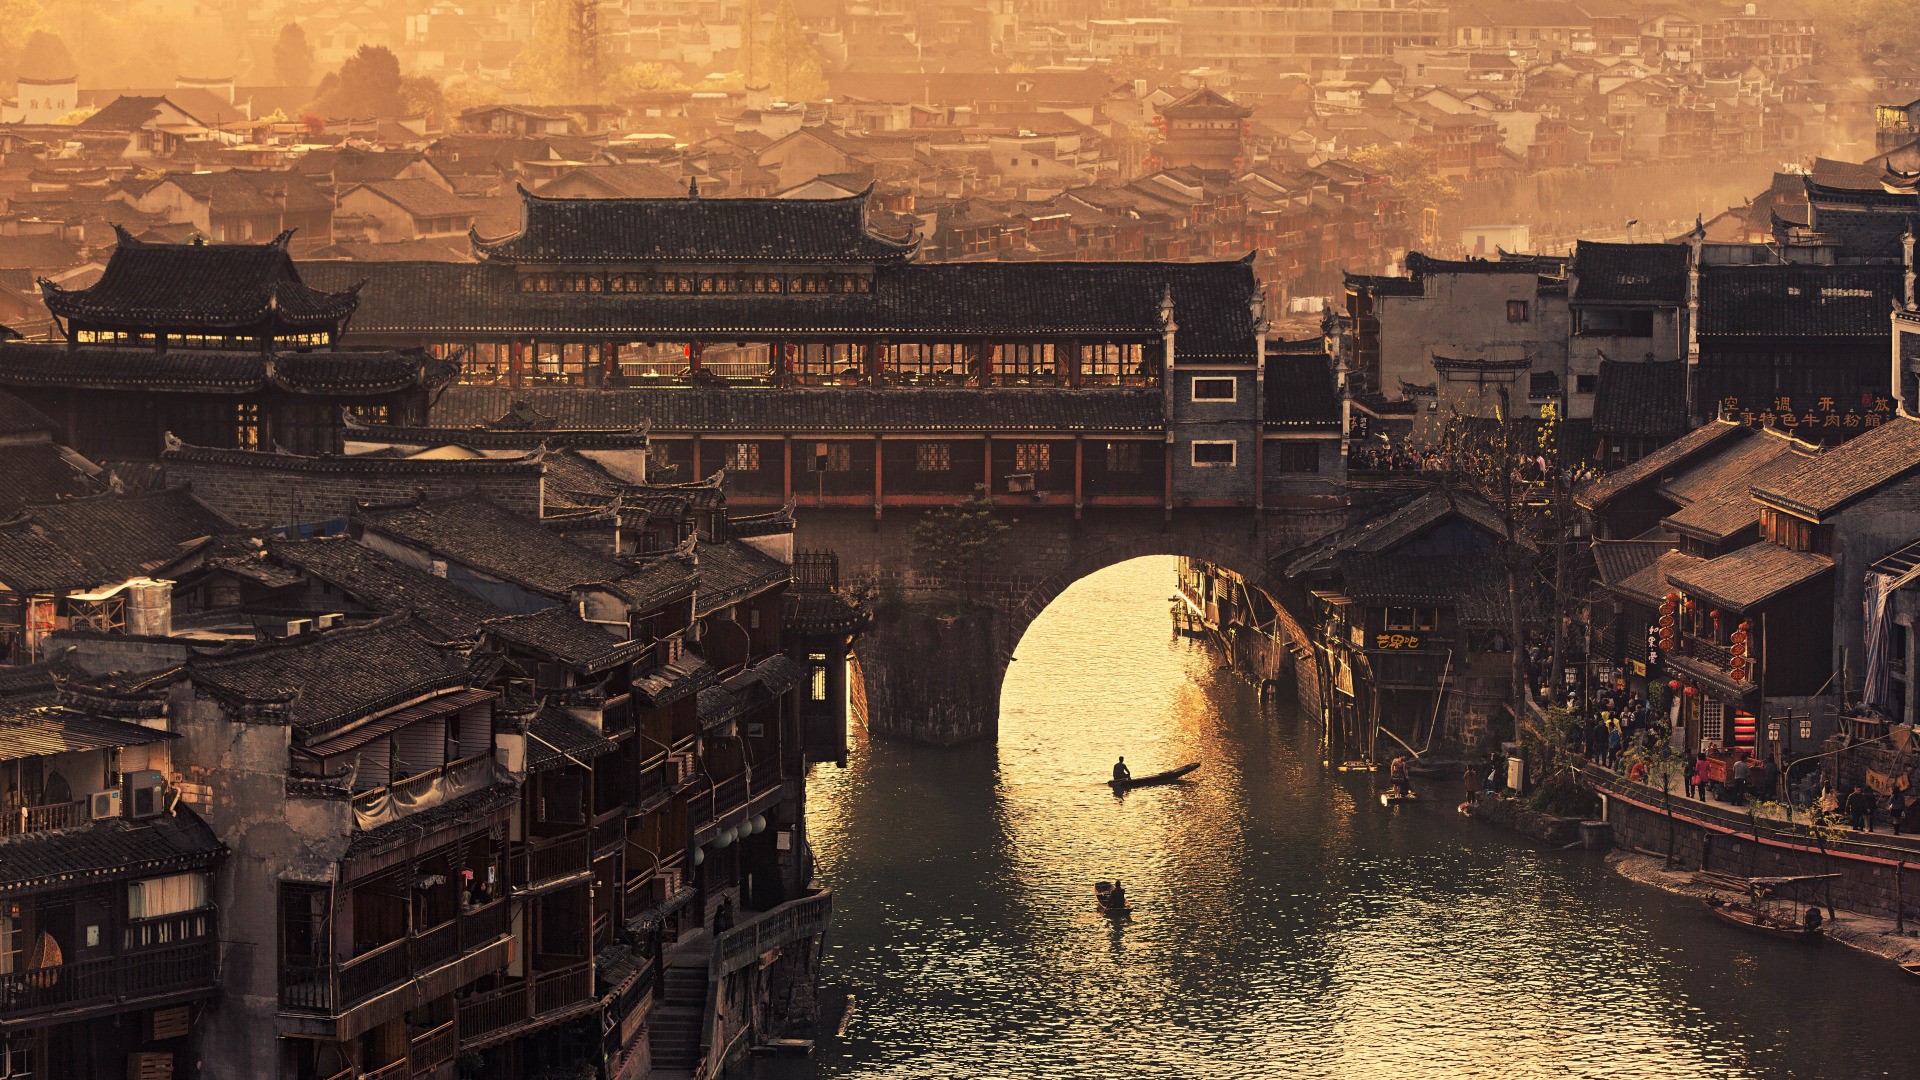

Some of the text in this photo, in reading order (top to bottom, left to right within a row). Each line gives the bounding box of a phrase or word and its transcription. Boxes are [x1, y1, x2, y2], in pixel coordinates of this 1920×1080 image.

[1725, 411, 1881, 428] 哥特色牛肉粉館
